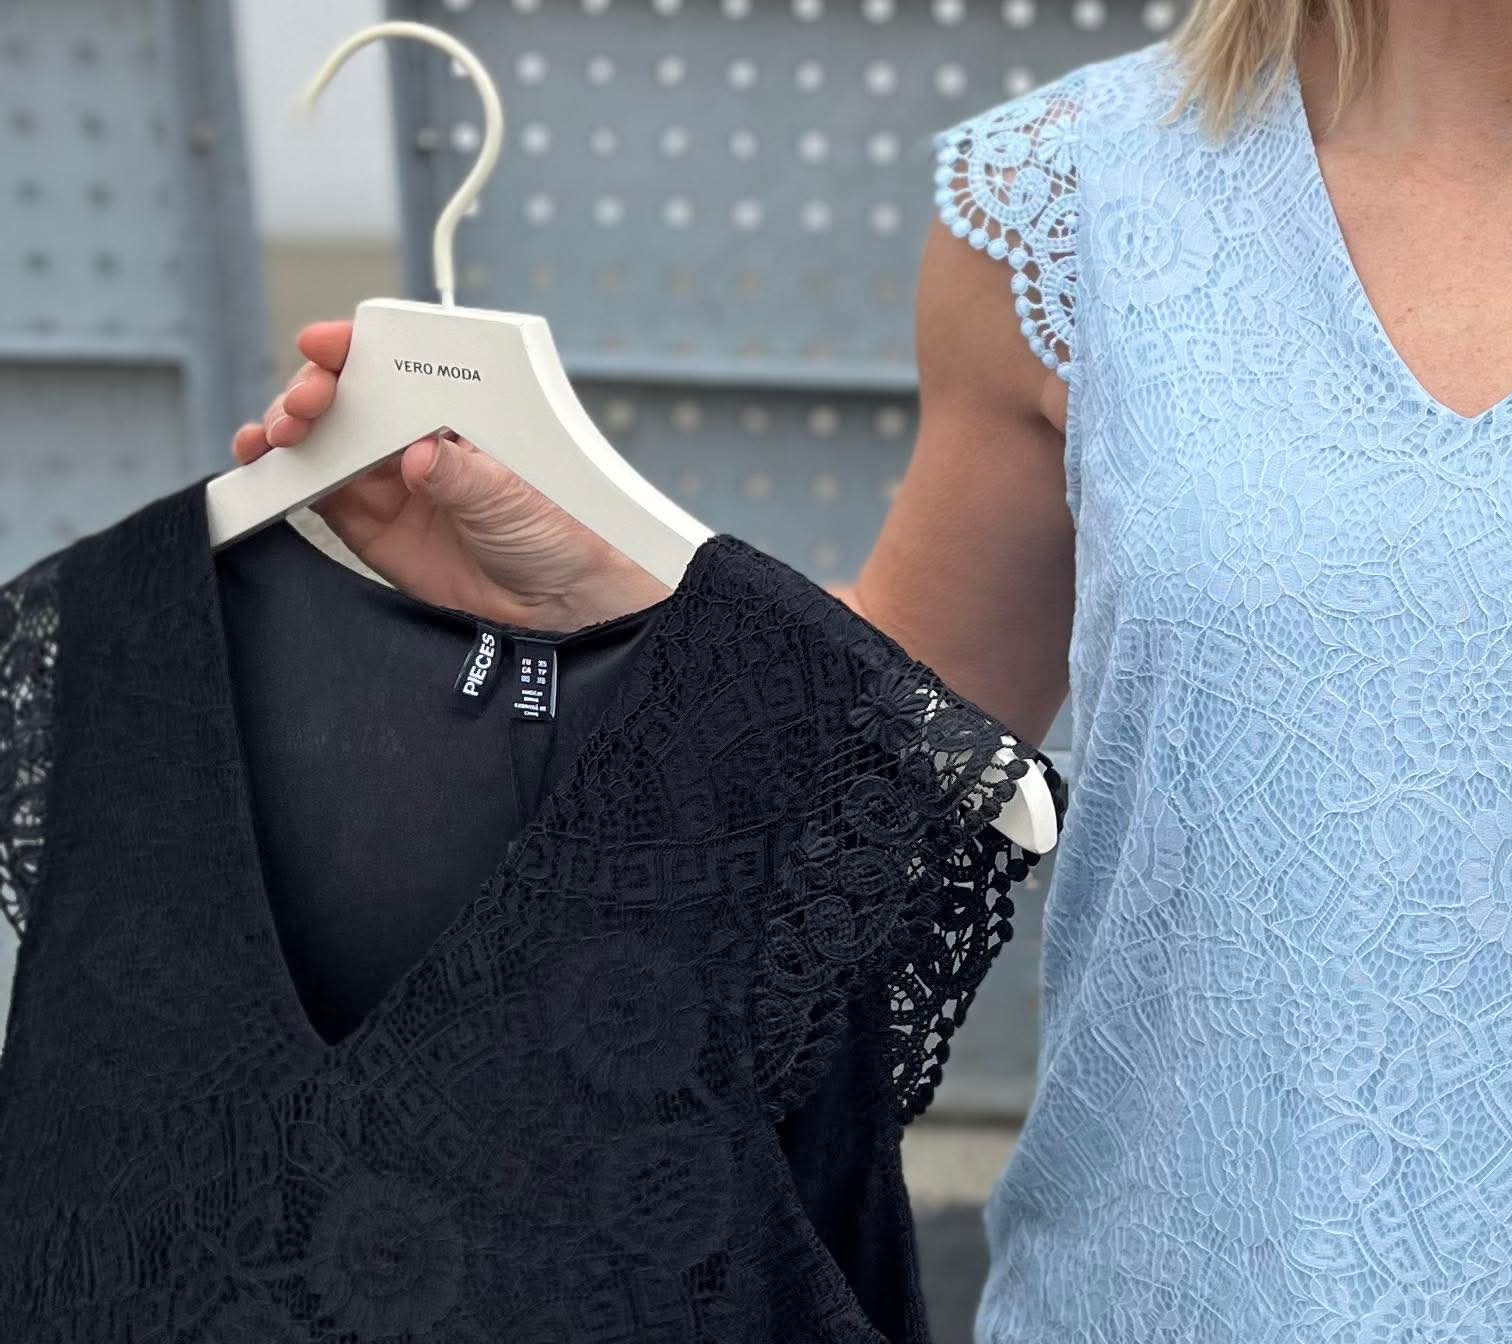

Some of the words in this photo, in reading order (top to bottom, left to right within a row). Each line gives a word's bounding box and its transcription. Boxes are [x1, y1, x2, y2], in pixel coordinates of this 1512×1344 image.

[394, 358, 433, 376] VERO
[437, 364, 482, 382] MODA
[462, 632, 496, 697] PIECES
